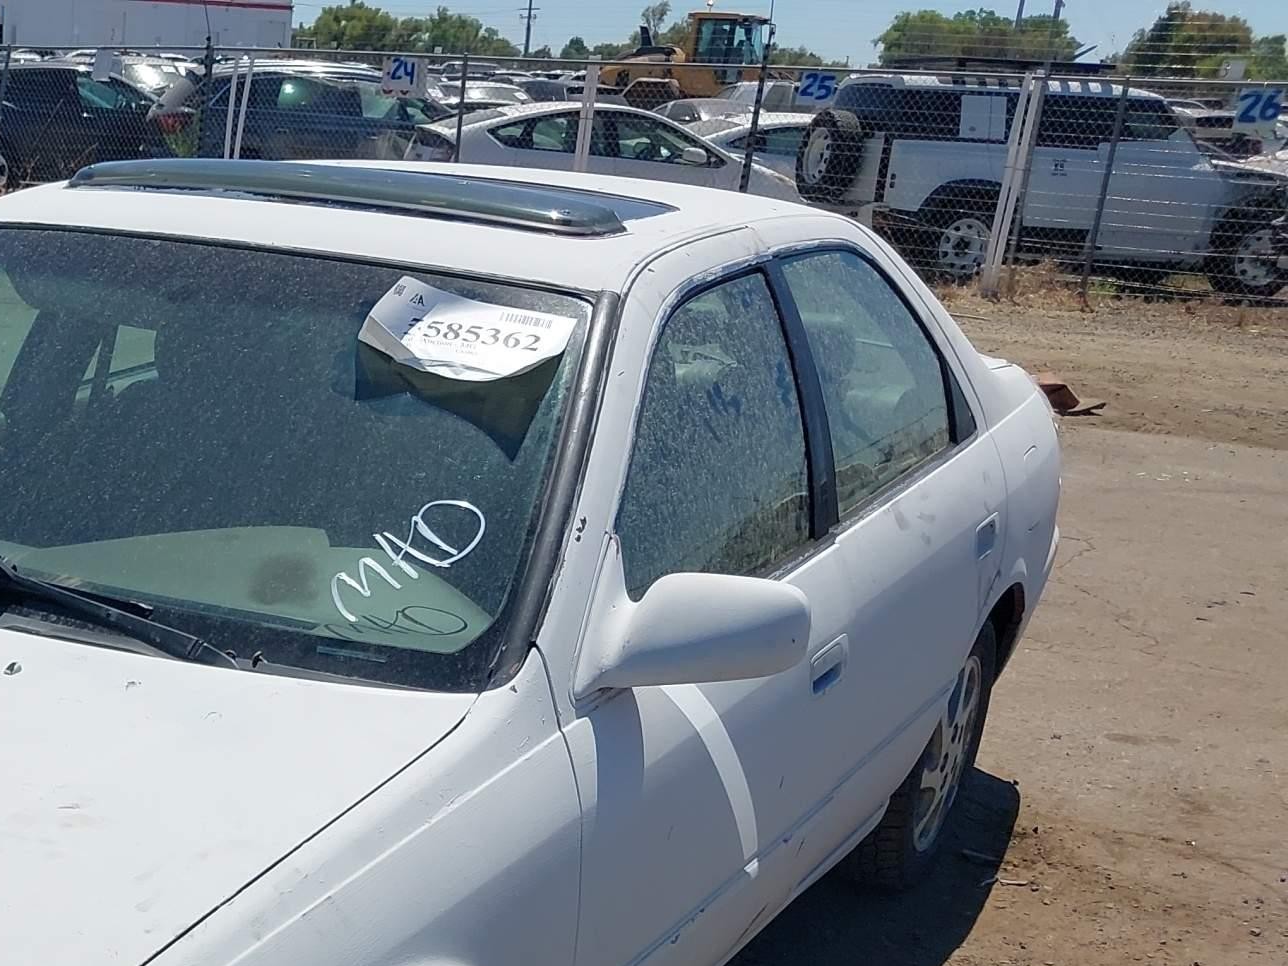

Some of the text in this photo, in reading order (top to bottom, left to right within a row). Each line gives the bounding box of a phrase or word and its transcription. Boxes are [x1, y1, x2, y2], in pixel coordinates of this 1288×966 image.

[390, 58, 416, 86] 24
[799, 72, 836, 100] 25
[1238, 89, 1283, 123] 26
[405, 317, 542, 352] 585362
